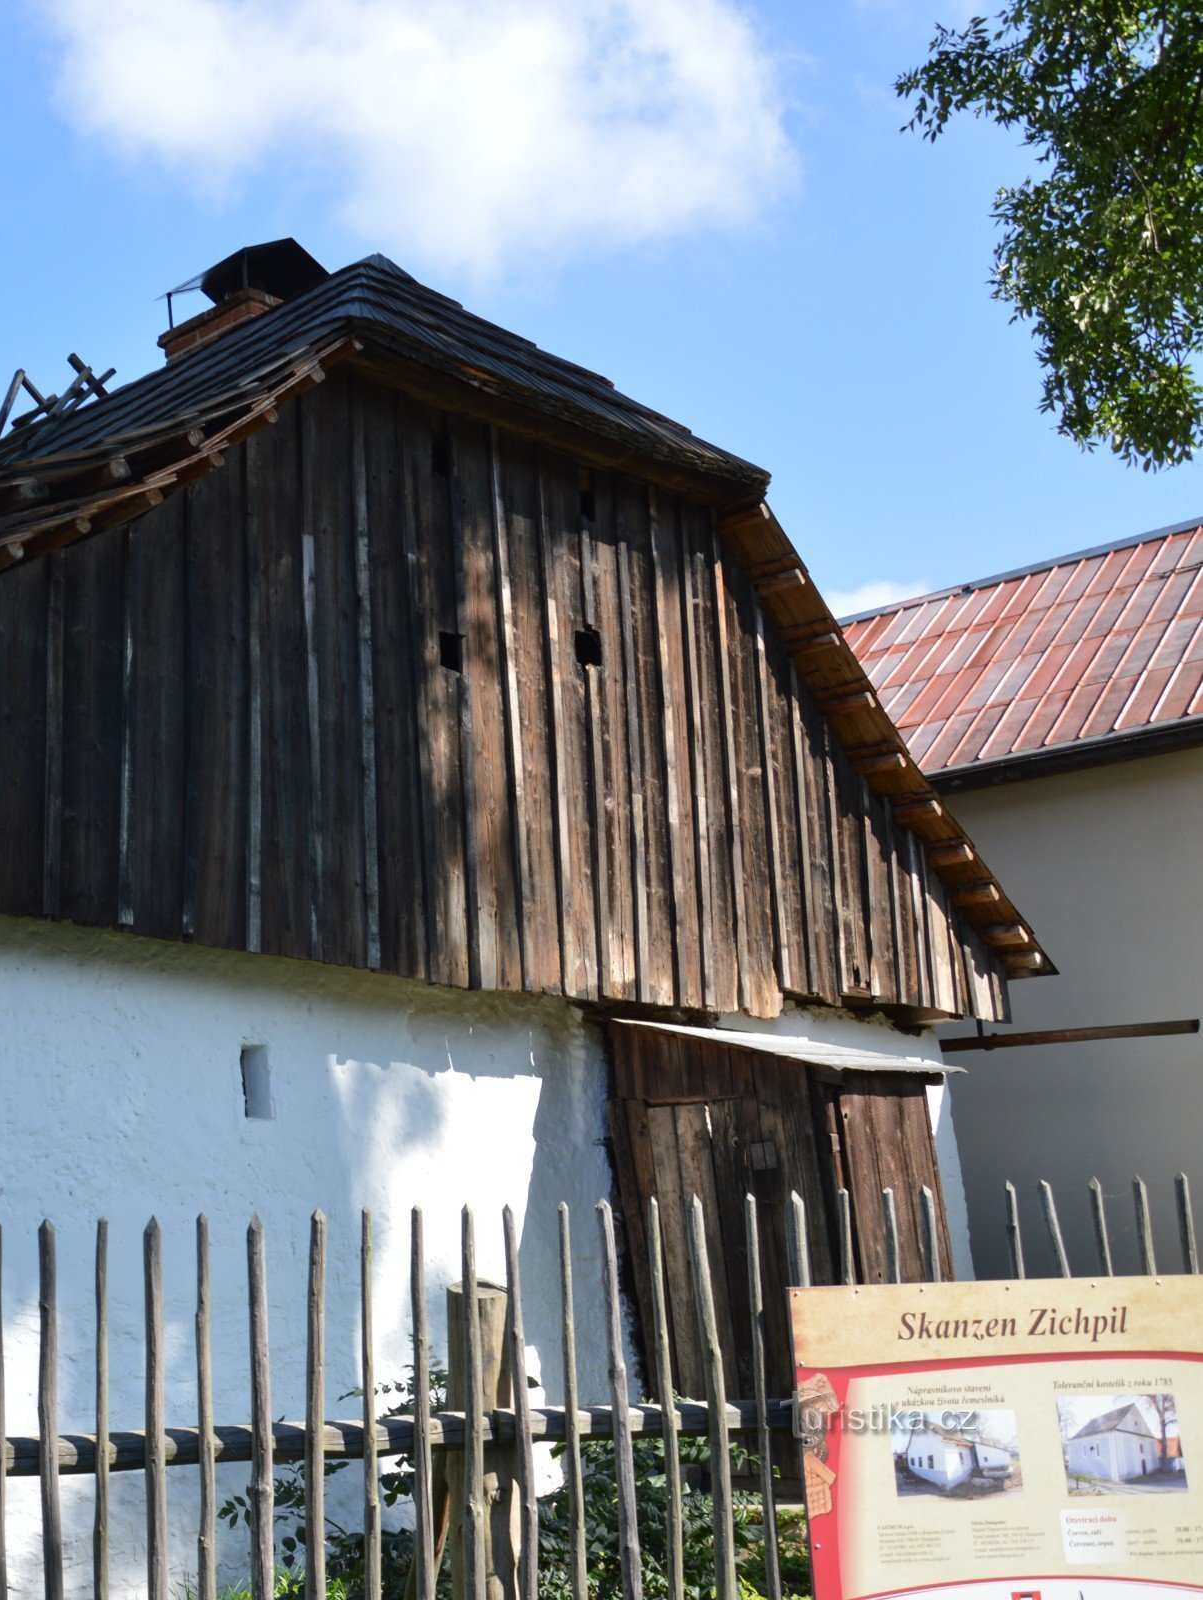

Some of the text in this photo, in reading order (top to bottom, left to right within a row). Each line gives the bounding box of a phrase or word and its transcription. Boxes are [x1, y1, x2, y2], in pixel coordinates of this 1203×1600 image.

[897, 1306, 1128, 1342] Skanzen Zichpil
[1053, 1380, 1094, 1389] Toleranční
[1134, 1378, 1152, 1387] roku
[1154, 1378, 1173, 1387] 1785
[902, 1397, 934, 1407] ukázkou
[937, 1396, 959, 1406] života
[1100, 1515, 1117, 1523] doba
